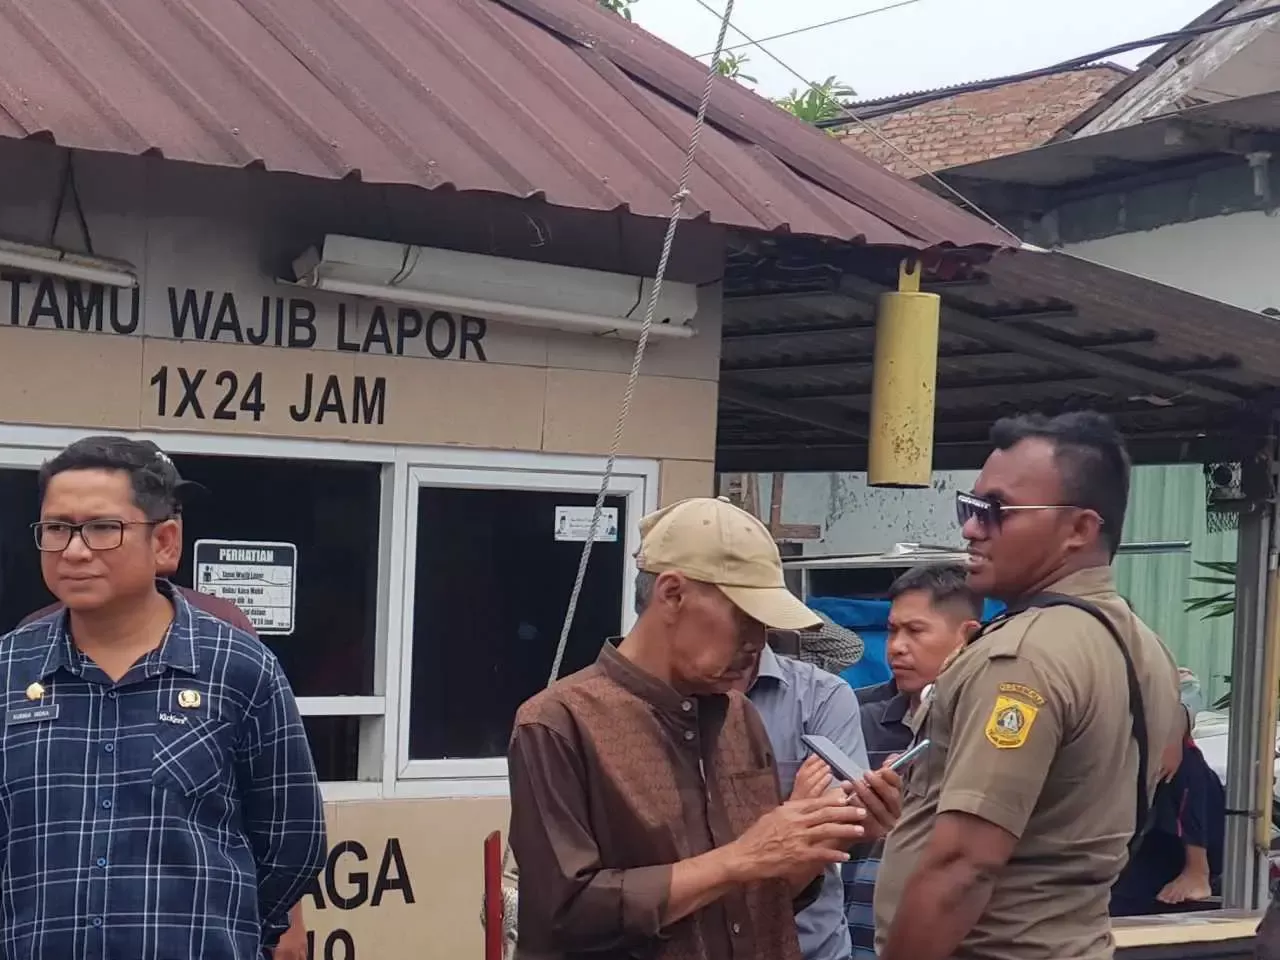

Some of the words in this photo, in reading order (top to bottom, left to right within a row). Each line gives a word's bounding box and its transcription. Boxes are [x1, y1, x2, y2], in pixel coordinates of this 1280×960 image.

[0, 272, 140, 335] TAMU
[167, 287, 318, 348] WAJIB
[337, 302, 487, 361] LAPOR
[149, 366, 266, 422] 1X24
[289, 372, 387, 425] JAM
[219, 548, 274, 563] PERHATIAN
